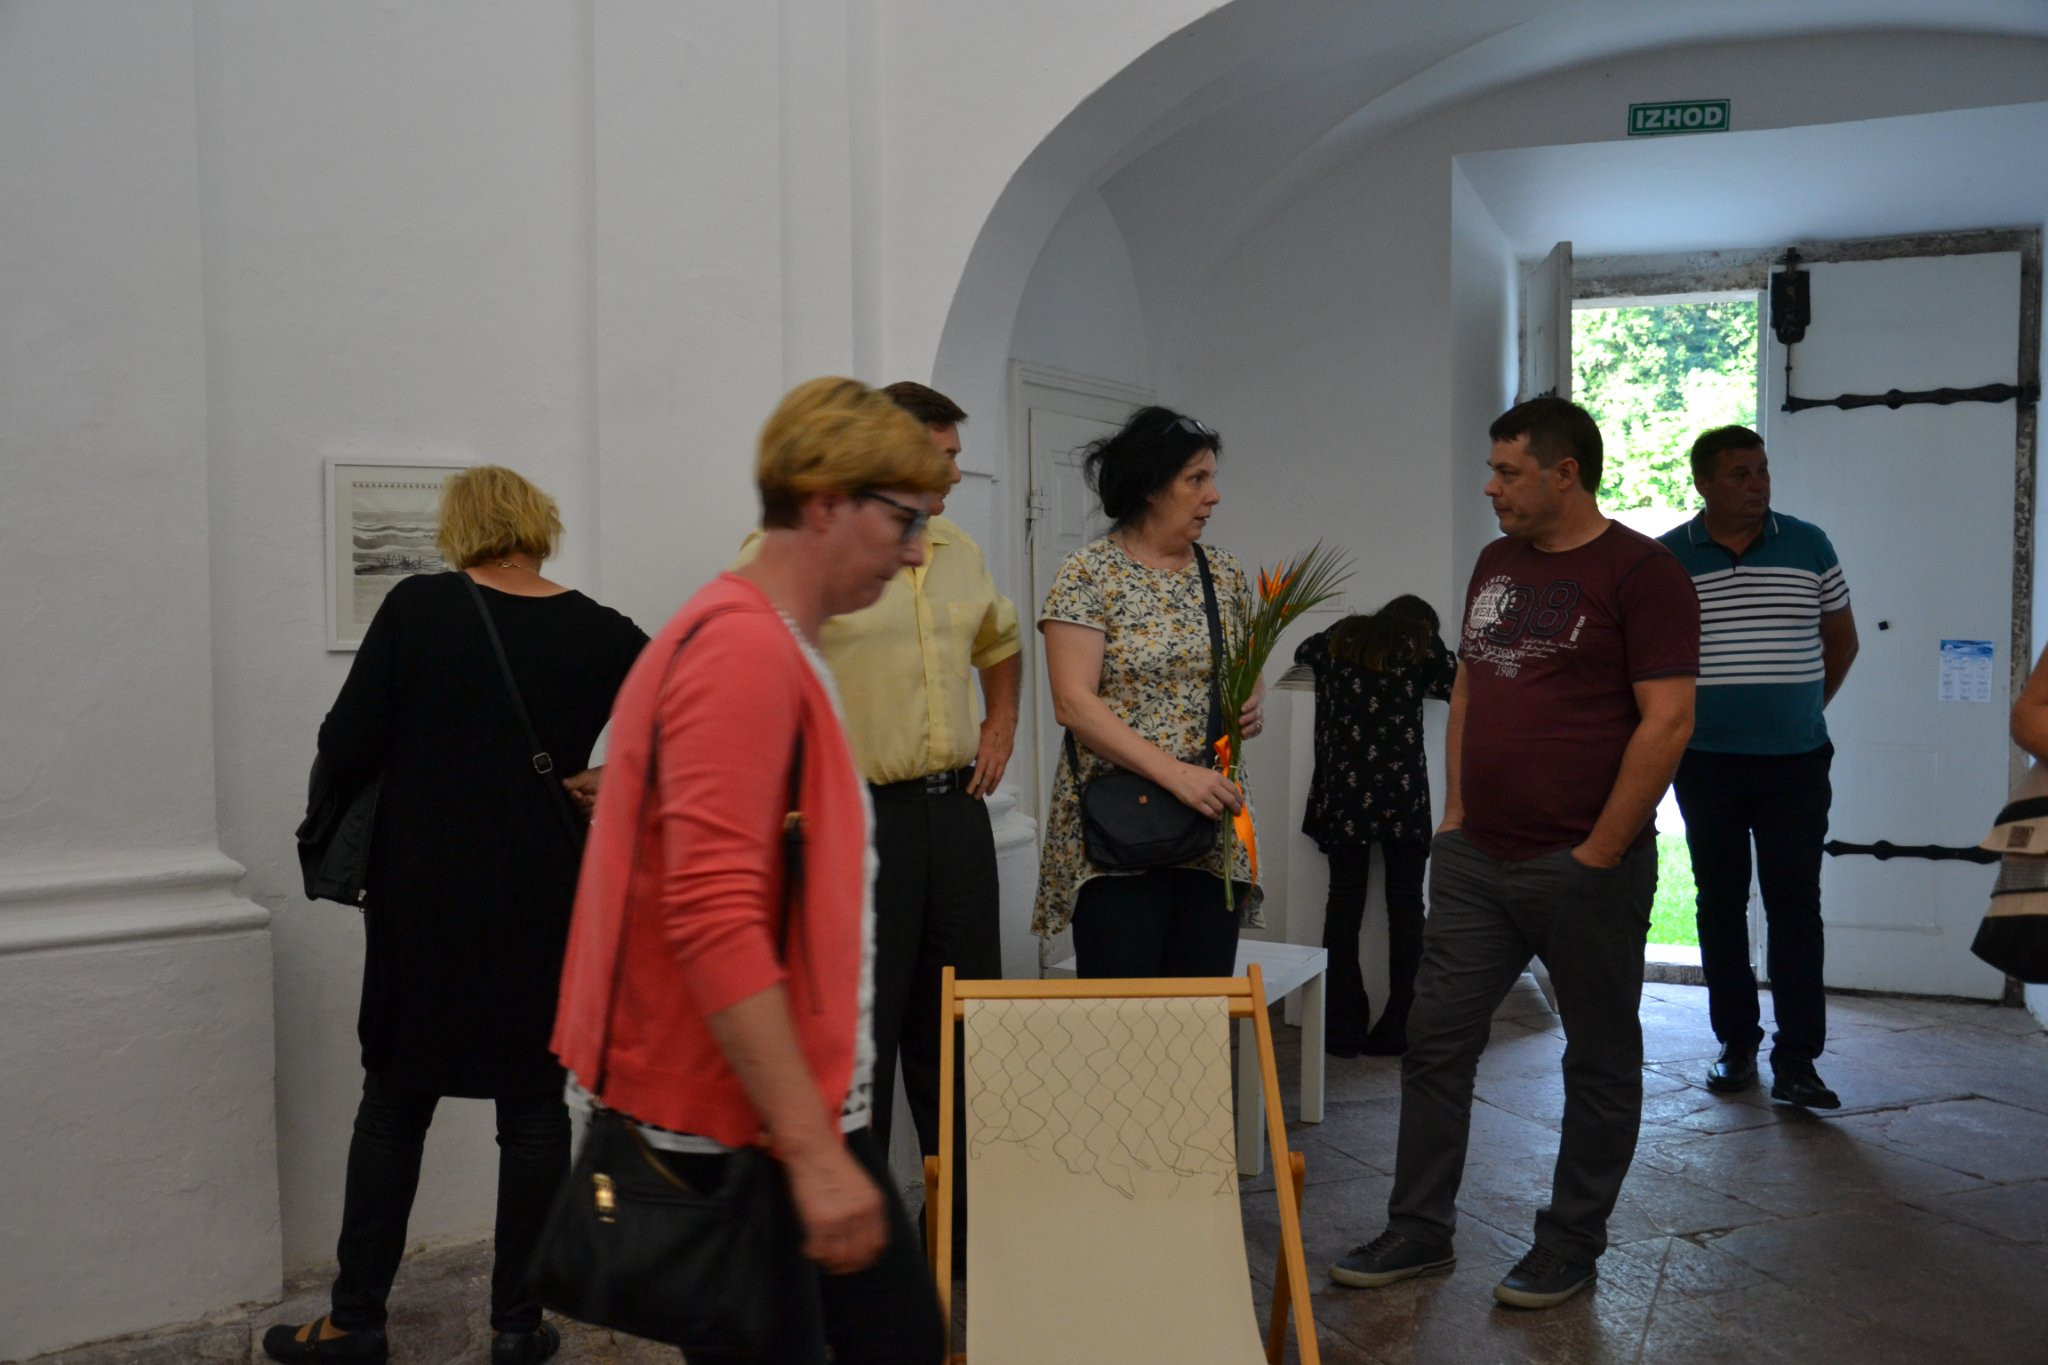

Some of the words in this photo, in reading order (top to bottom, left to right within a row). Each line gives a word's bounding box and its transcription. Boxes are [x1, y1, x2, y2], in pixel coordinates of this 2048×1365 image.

[1636, 106, 1723, 129] IZHOD
[1486, 581, 1579, 644] 98
[1495, 665, 1518, 679] 1980
